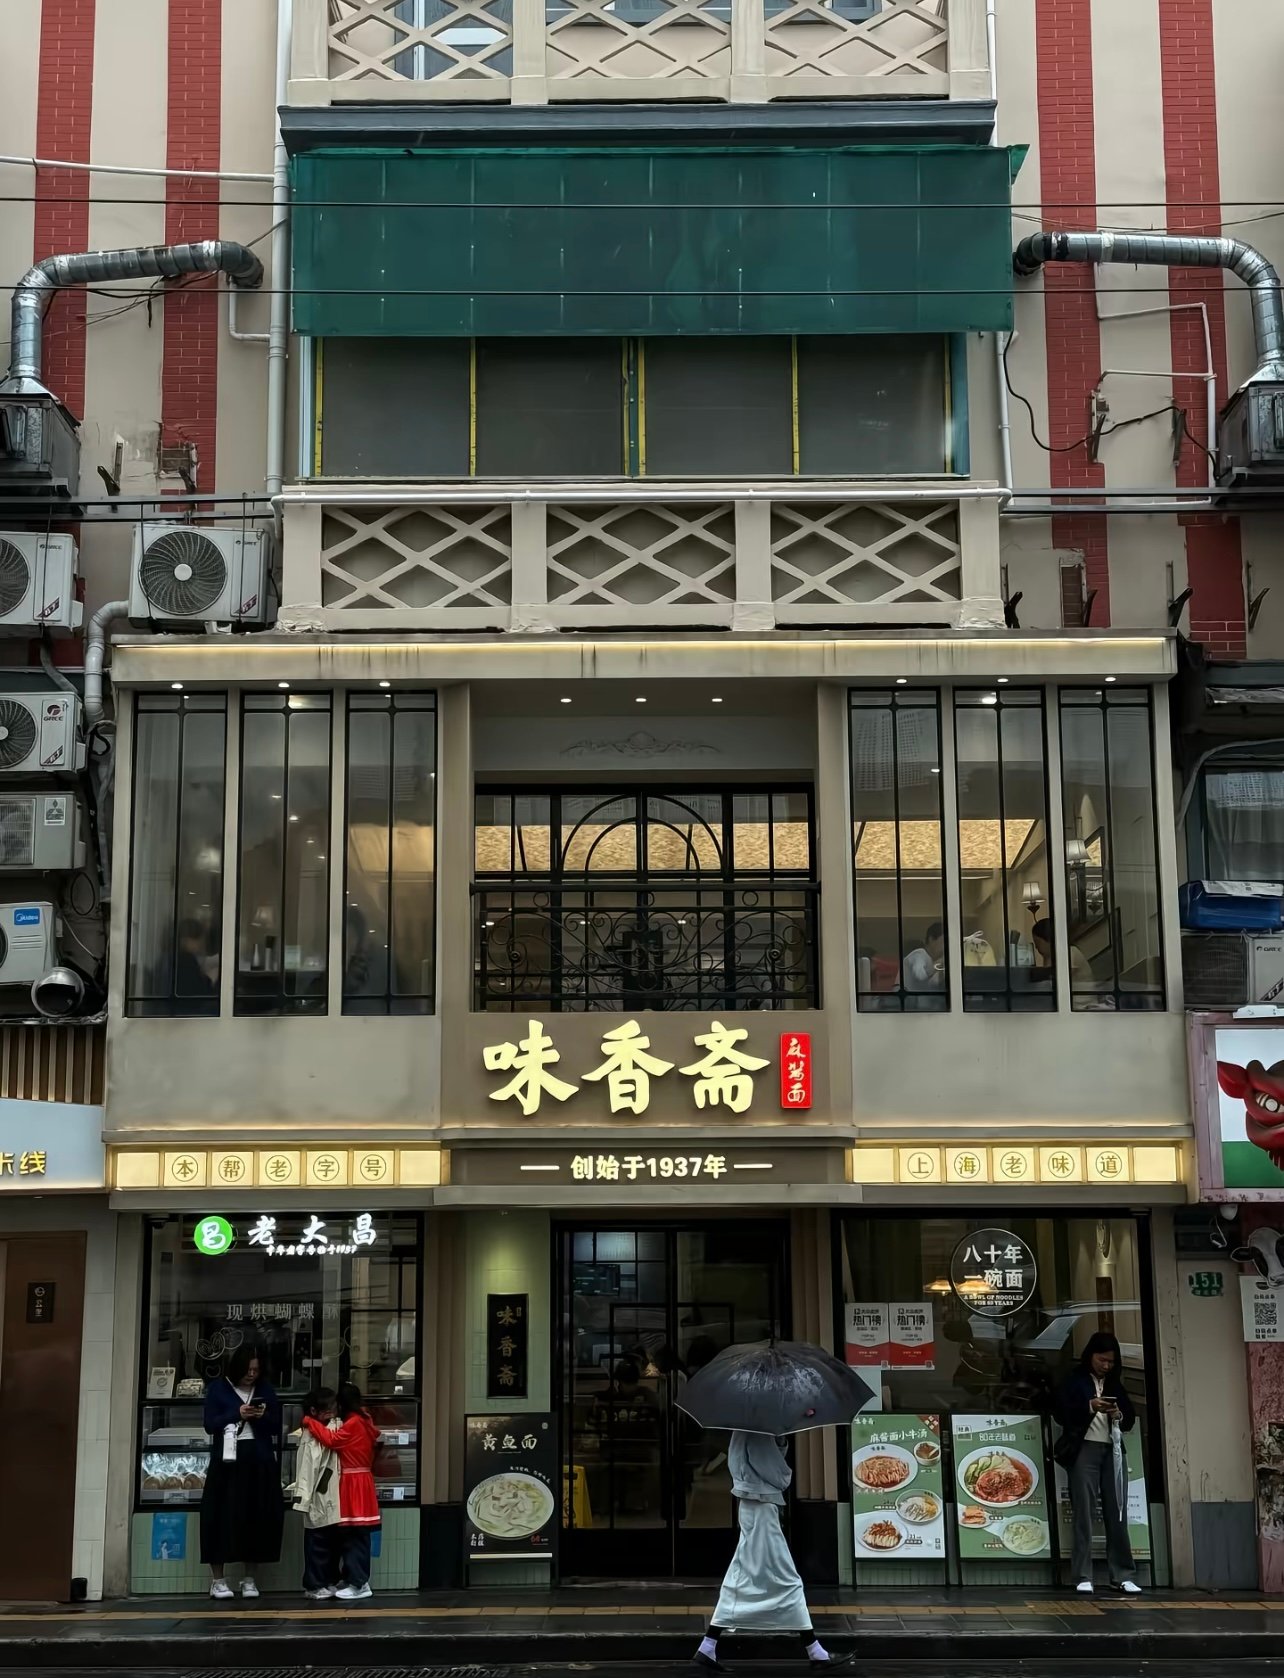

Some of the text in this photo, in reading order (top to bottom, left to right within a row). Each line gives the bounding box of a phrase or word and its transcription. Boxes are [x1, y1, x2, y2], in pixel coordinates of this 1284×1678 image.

[482, 1019, 771, 1115] 味香斋
[174, 1156, 385, 1180] 本帮老字号
[570, 1154, 728, 1180] 创始于1937年
[911, 1154, 1120, 1178] 上海老味道
[248, 1213, 377, 1246] 老大昌
[963, 1244, 1024, 1264] 八十年
[963, 1268, 1024, 1288] 一碗面
[1191, 1273, 1221, 1288] 151
[853, 1315, 881, 1326] 热门榜
[897, 1315, 926, 1326] 热门榜
[496, 1305, 518, 1387] 味香斋
[481, 1433, 538, 1451] 黄鱼面
